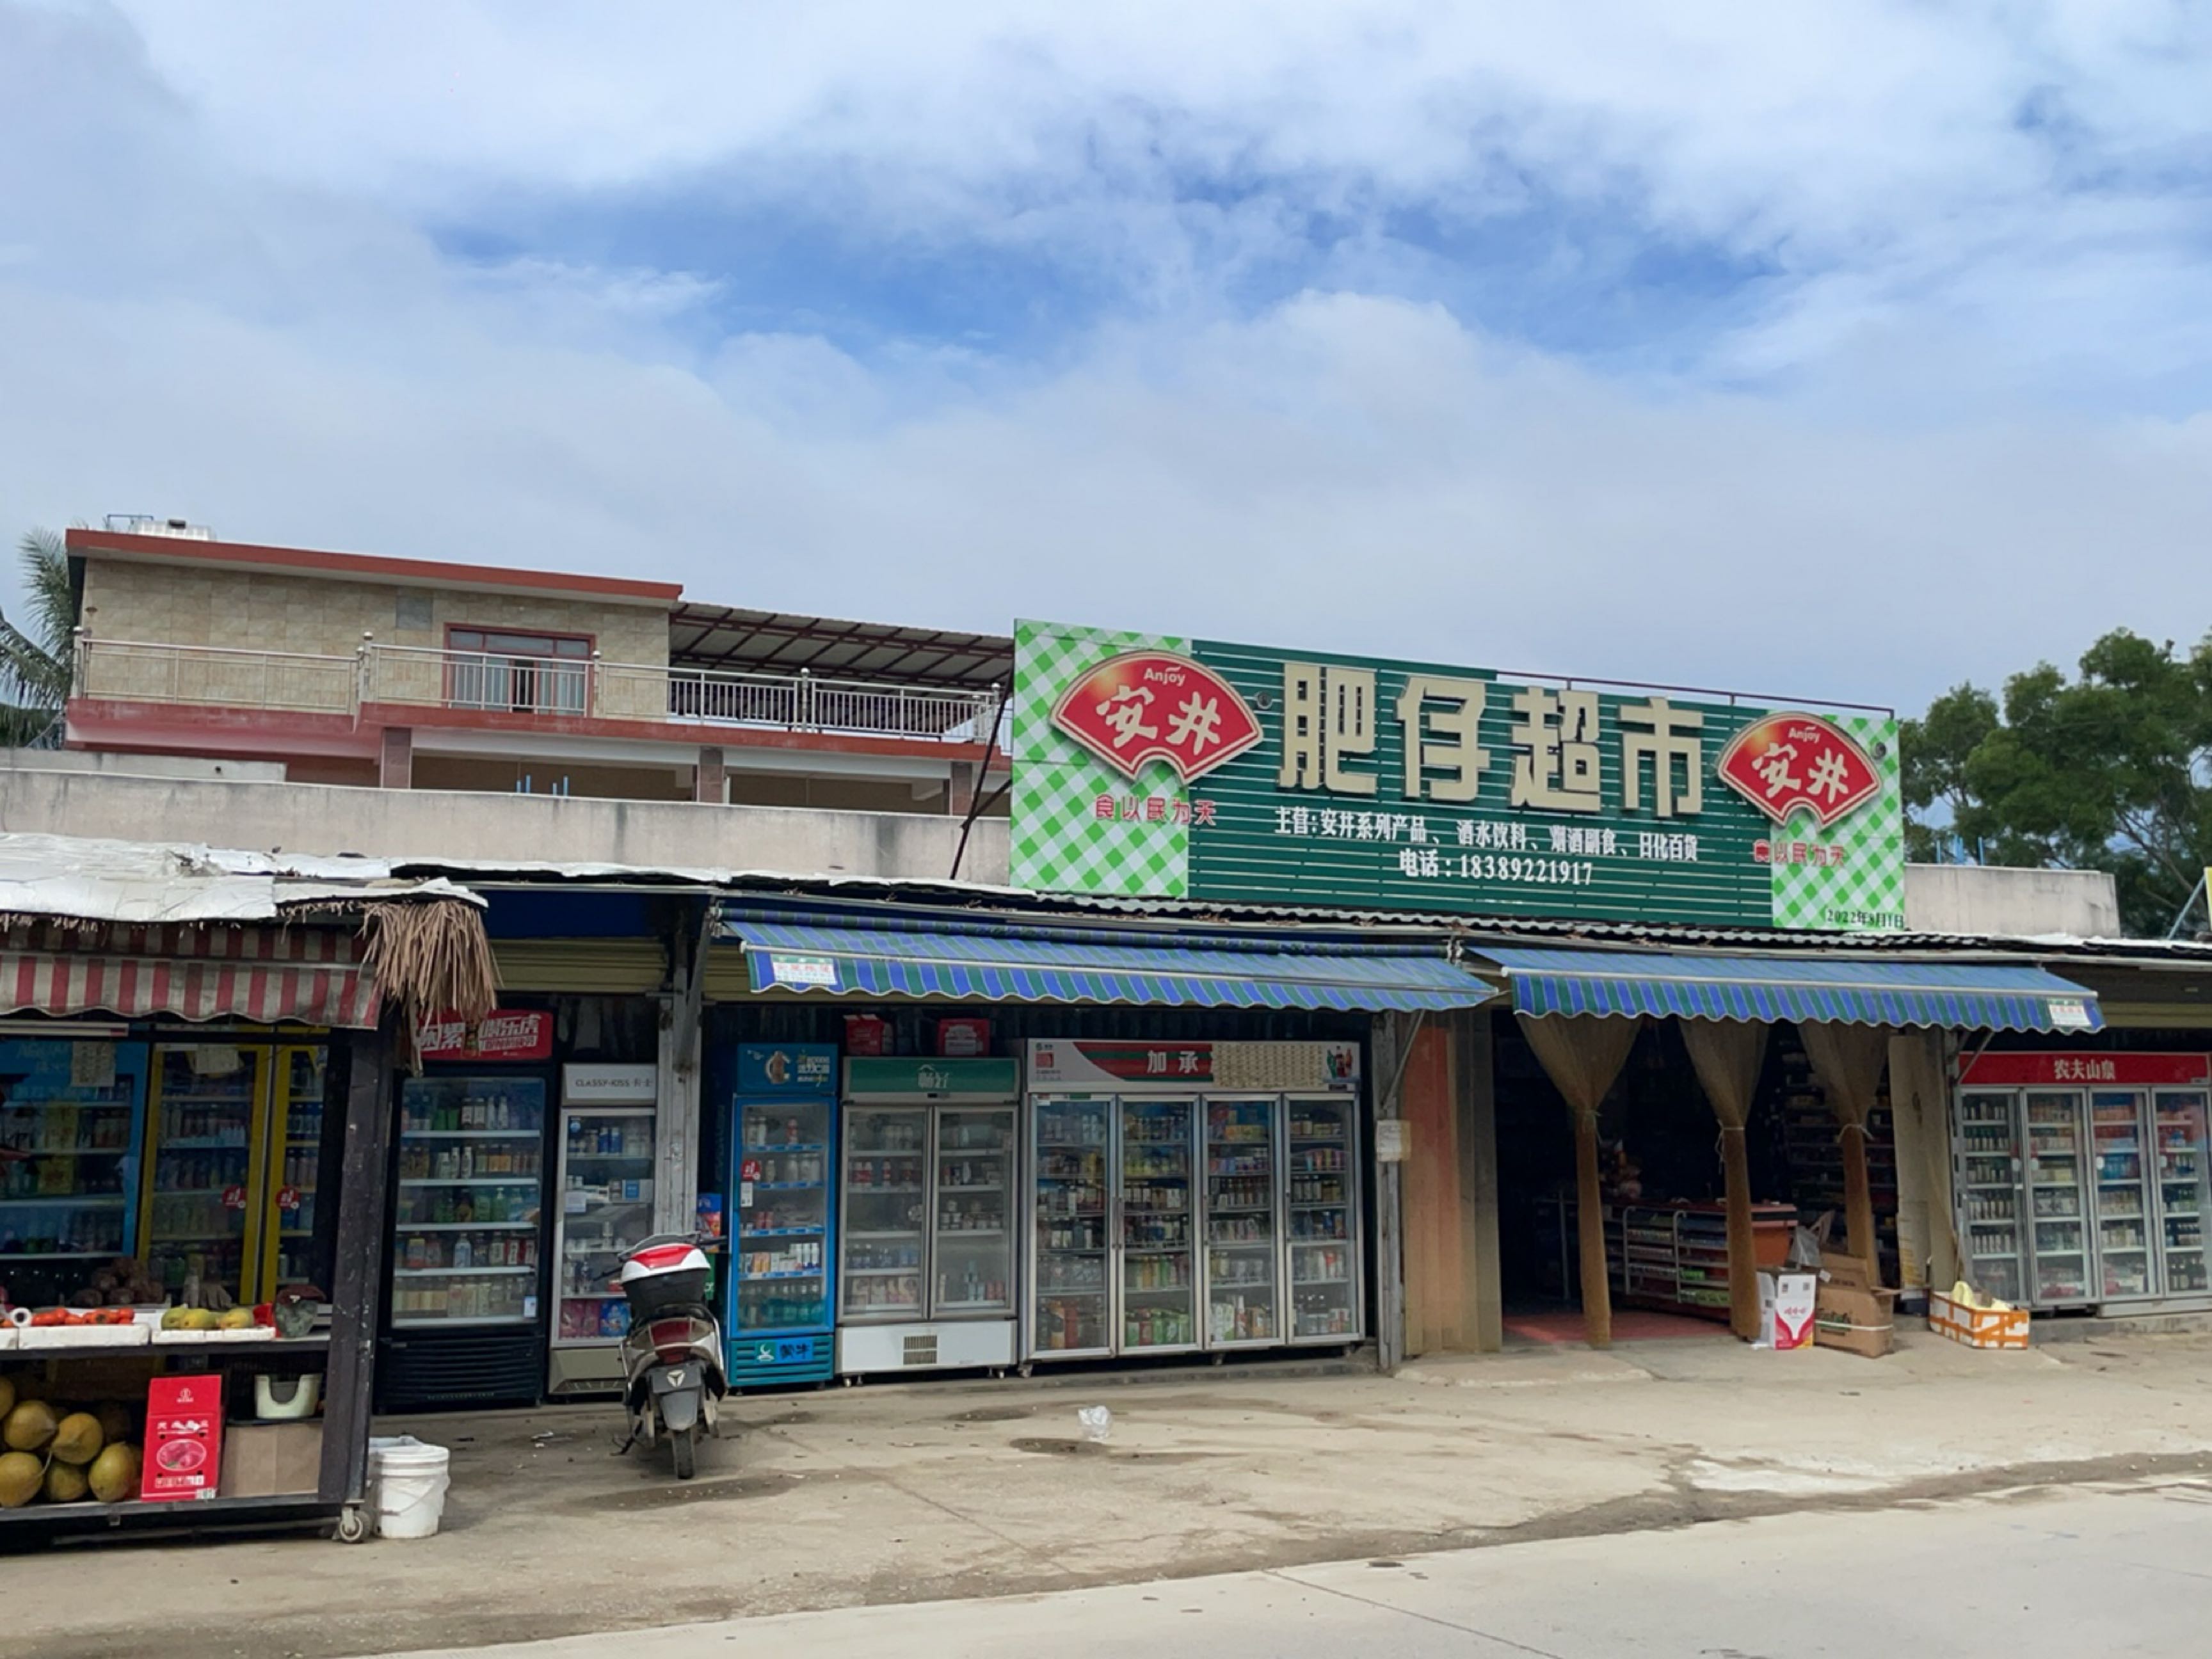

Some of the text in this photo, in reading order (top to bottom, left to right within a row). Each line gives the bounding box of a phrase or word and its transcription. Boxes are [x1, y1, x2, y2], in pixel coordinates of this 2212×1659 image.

[1144, 666, 1186, 687] Anjoy
[1096, 685, 1222, 757] 安井
[1788, 726, 1820, 744] Anjoy
[1276, 662, 1704, 818] 肥仔超市
[1751, 742, 1849, 805] 安井
[1095, 794, 1216, 826] 食以民为天
[2054, 1059, 2116, 1080] 农夫山泉
